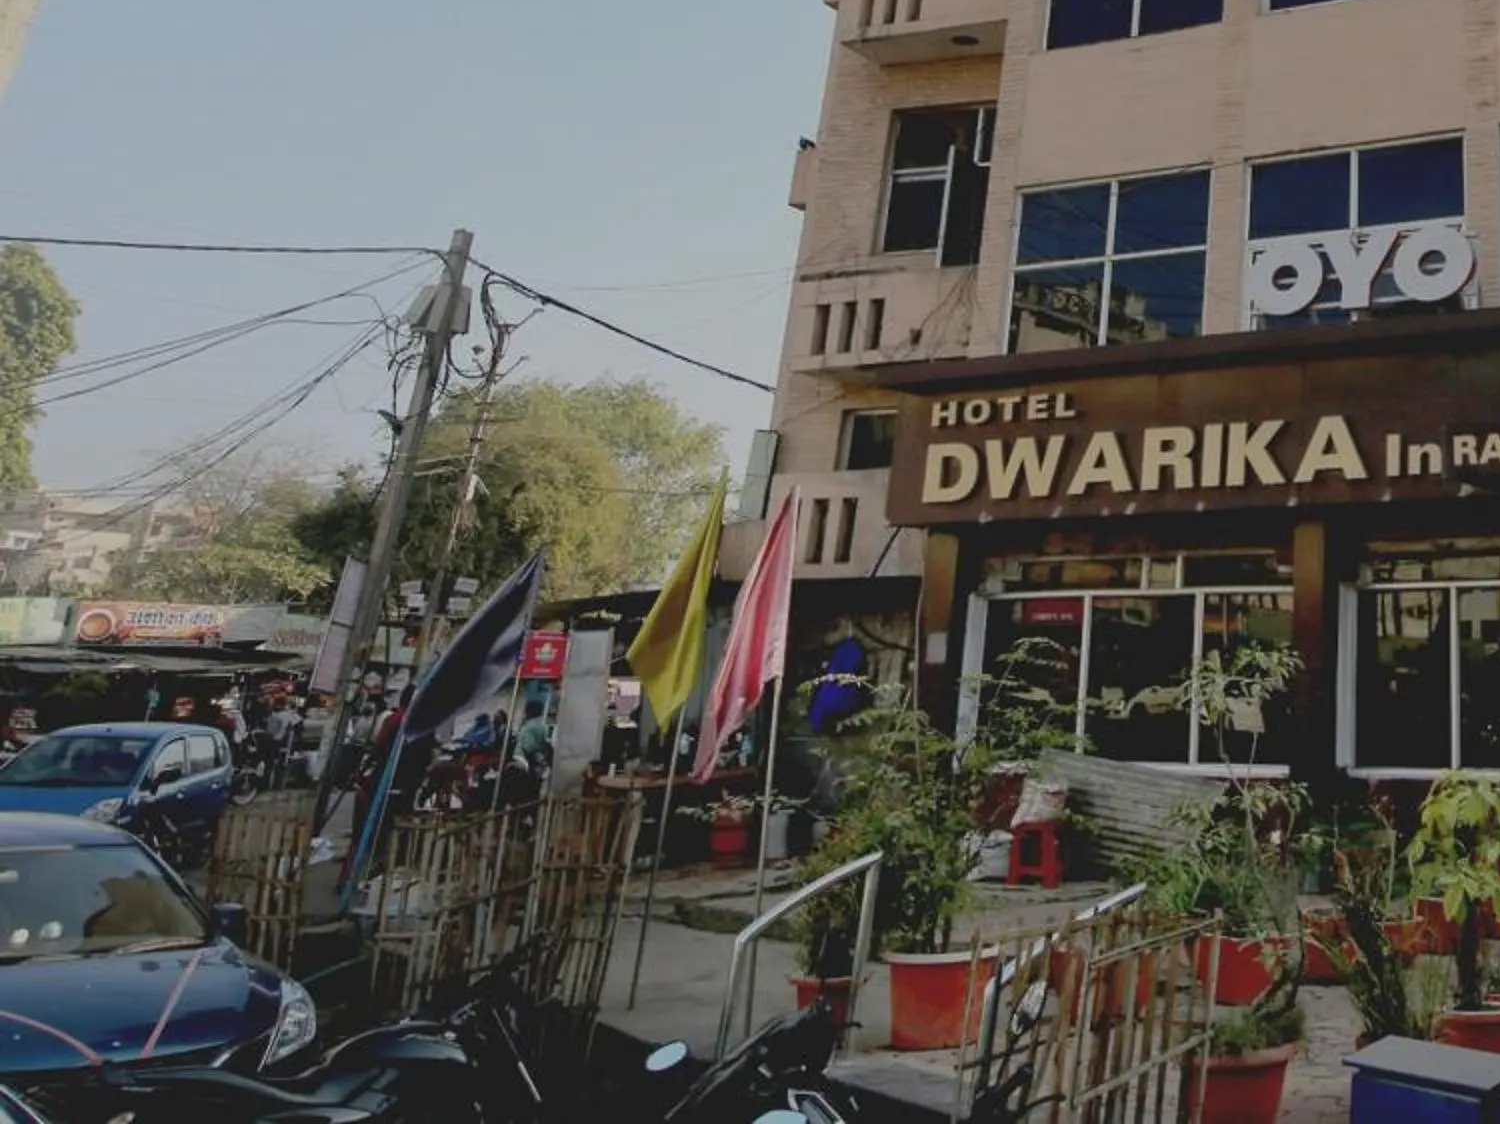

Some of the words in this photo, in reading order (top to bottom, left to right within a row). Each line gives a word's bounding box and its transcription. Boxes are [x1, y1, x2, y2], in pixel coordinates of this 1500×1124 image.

[1247, 226, 1476, 316] OYO
[930, 392, 1076, 427] HOTEL
[920, 415, 1367, 504] DWARIKA
[1385, 433, 1442, 476] In
